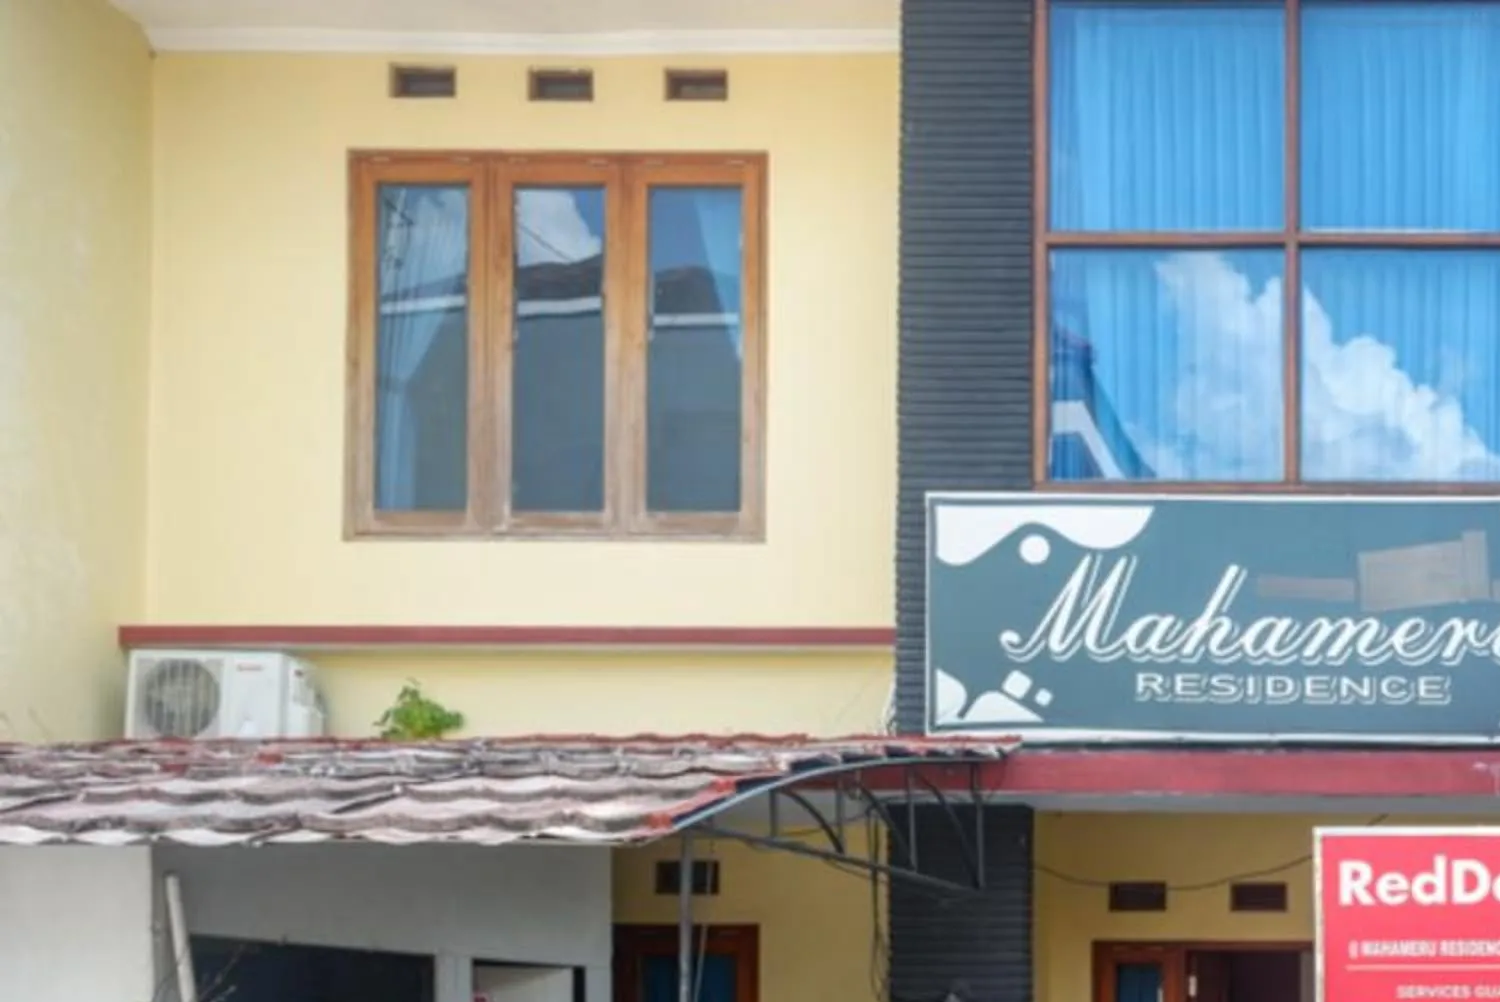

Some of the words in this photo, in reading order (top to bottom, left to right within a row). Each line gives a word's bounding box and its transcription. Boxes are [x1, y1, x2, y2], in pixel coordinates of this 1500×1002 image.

[1134, 672, 1452, 705] RESIDENCE
[1361, 940, 1436, 957] MAHAMERU
[1396, 984, 1472, 999] SERVICES
